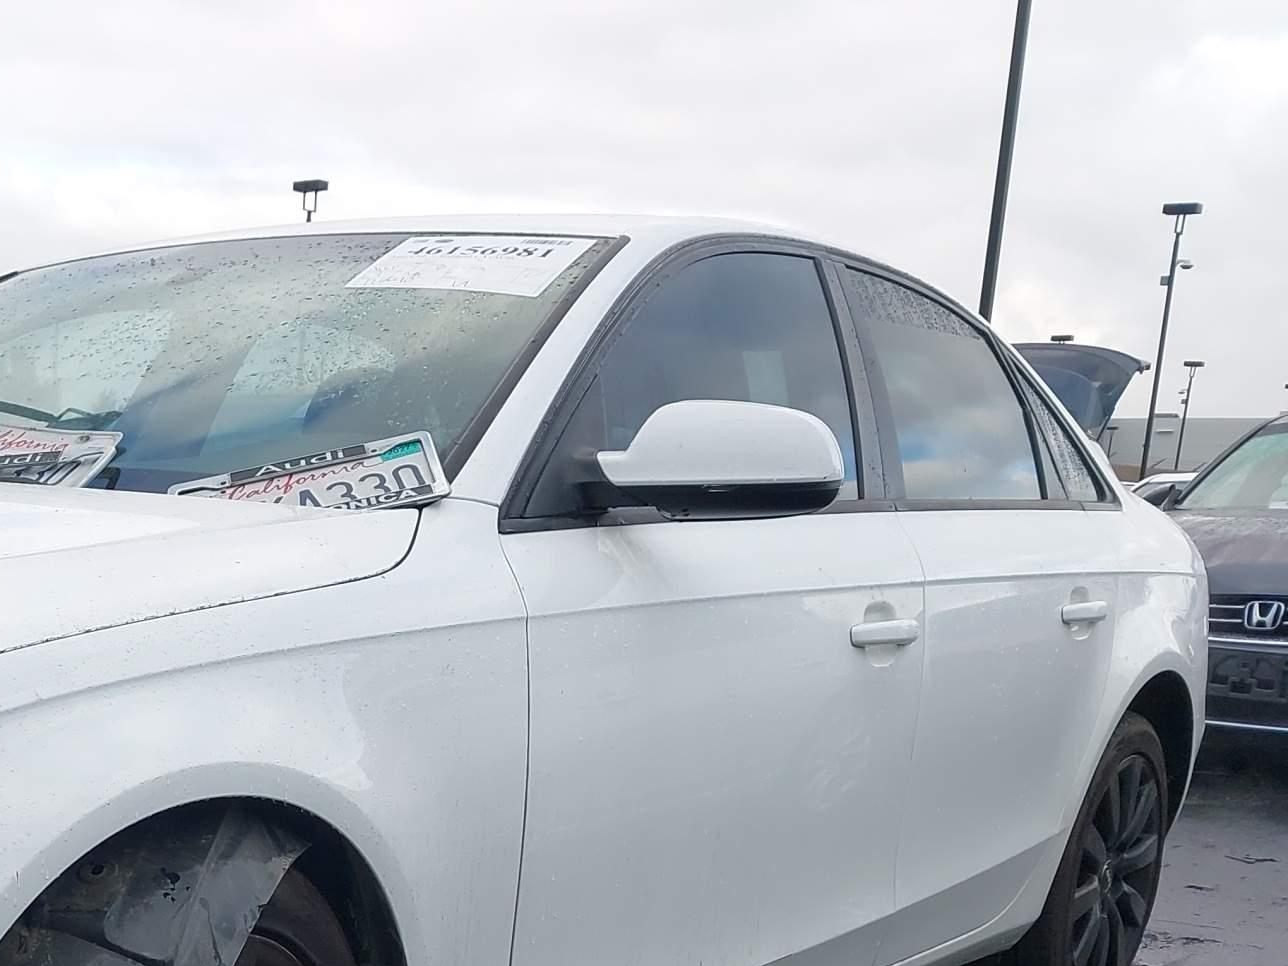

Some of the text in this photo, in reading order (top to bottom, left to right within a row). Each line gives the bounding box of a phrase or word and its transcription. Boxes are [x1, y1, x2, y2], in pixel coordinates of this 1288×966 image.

[408, 245, 555, 259] 46156981
[255, 448, 345, 478] Audi
[228, 460, 375, 501] California
